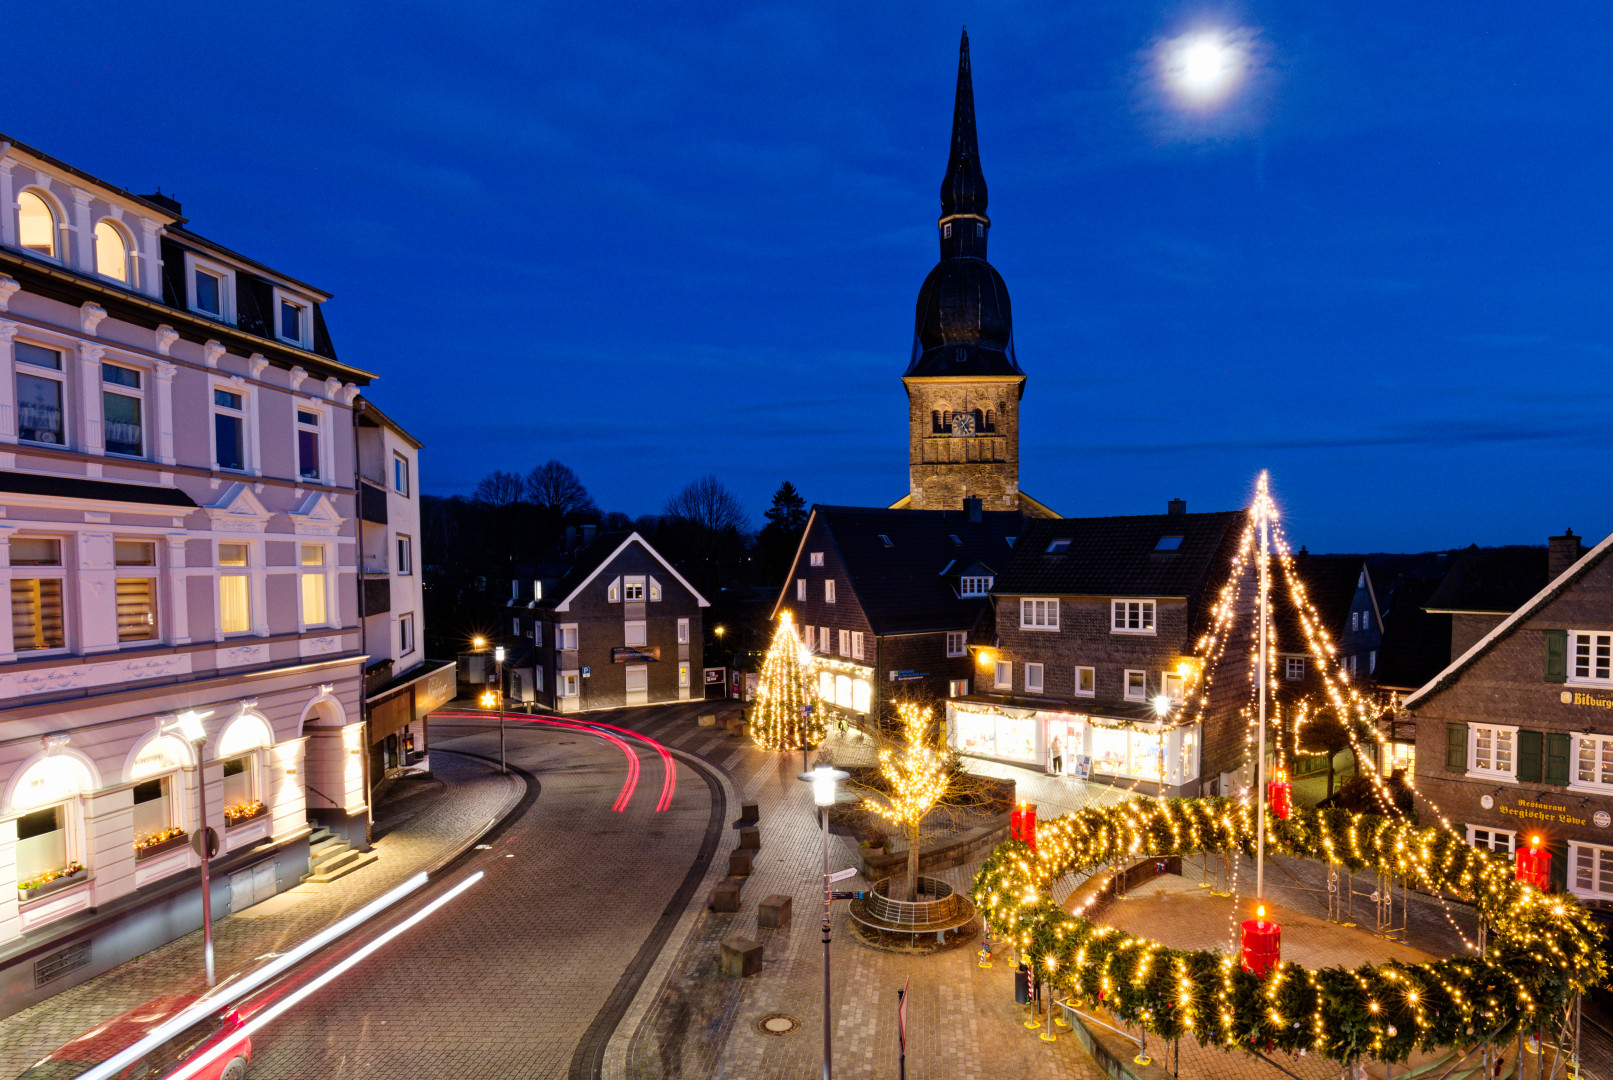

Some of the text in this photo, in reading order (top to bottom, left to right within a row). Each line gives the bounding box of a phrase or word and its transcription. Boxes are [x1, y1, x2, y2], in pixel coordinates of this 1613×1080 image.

[1518, 799, 1567, 812] Restaurant
[1499, 805, 1556, 821] Bergischer
[1559, 814, 1587, 826] Löwe
